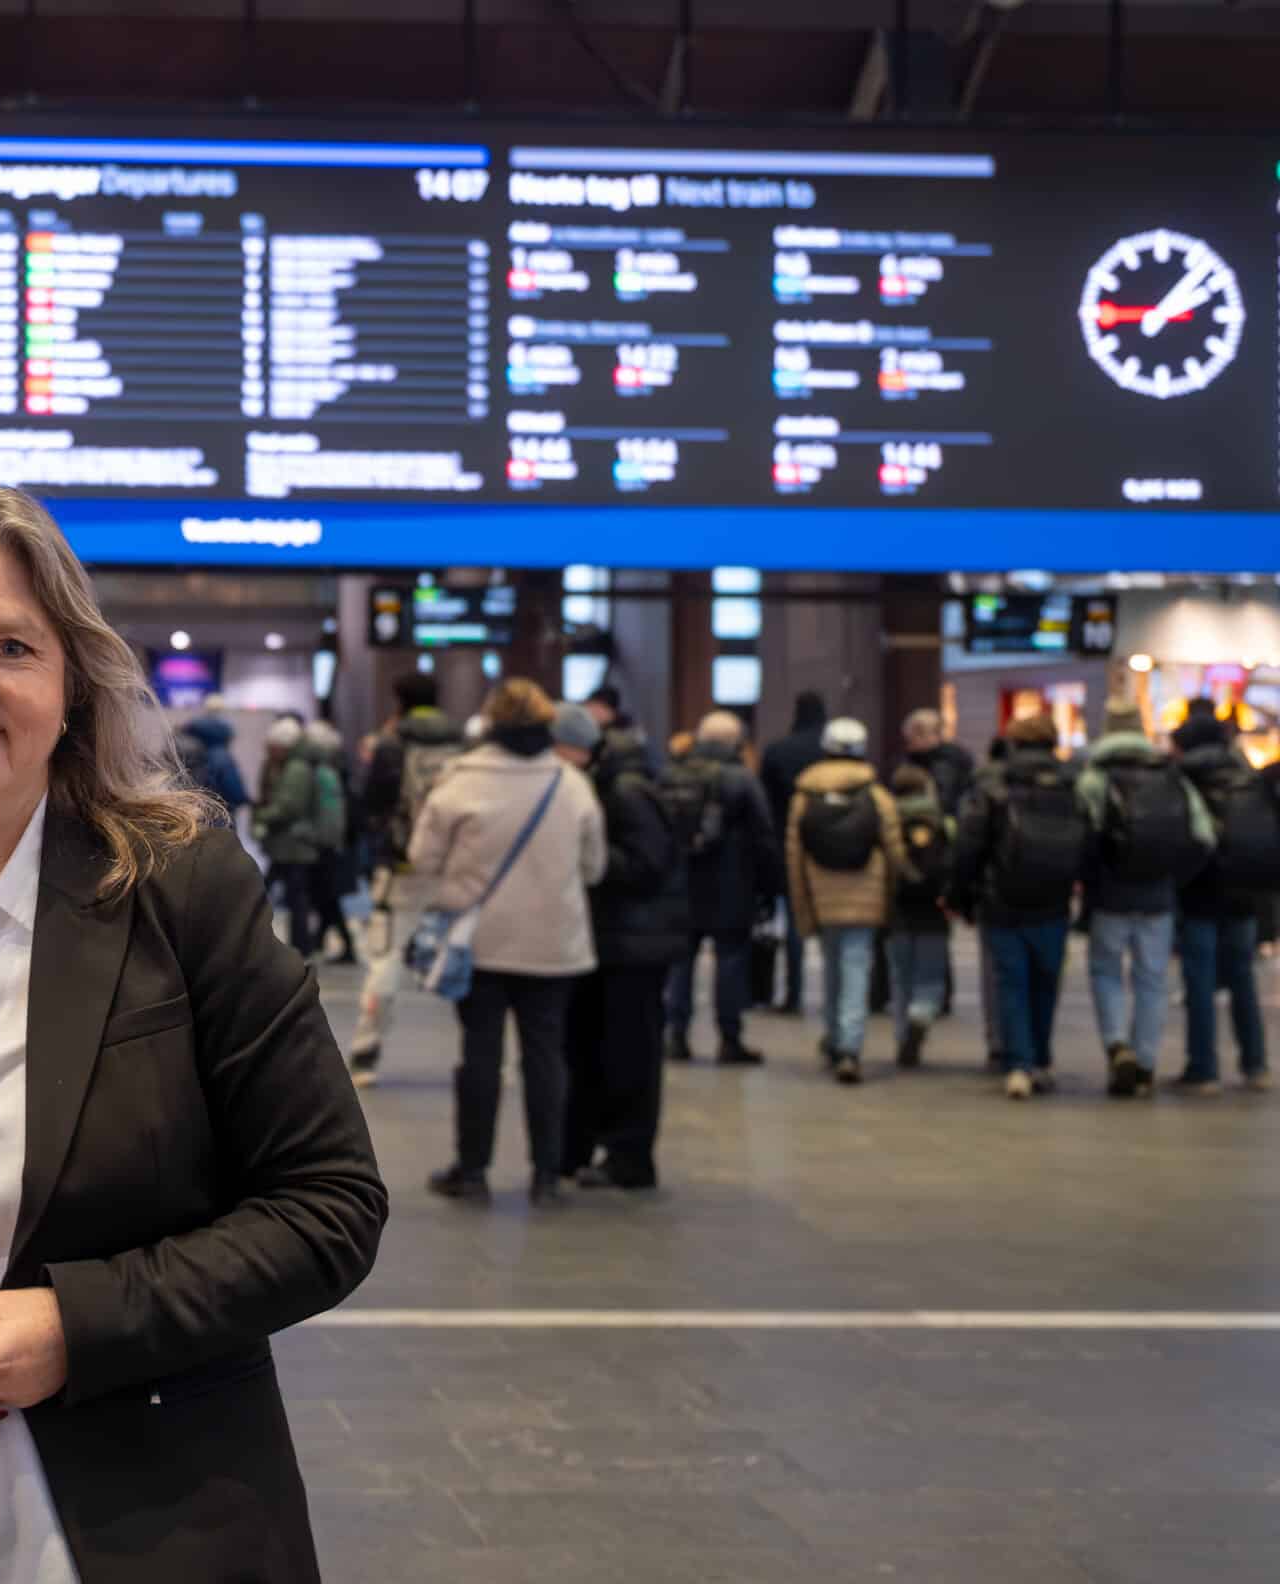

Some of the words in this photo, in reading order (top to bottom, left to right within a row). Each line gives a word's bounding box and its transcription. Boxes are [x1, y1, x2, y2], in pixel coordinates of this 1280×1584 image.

[102, 165, 237, 199] Departures
[666, 177, 724, 207] Next
[727, 179, 784, 208] train
[785, 180, 816, 209] to
